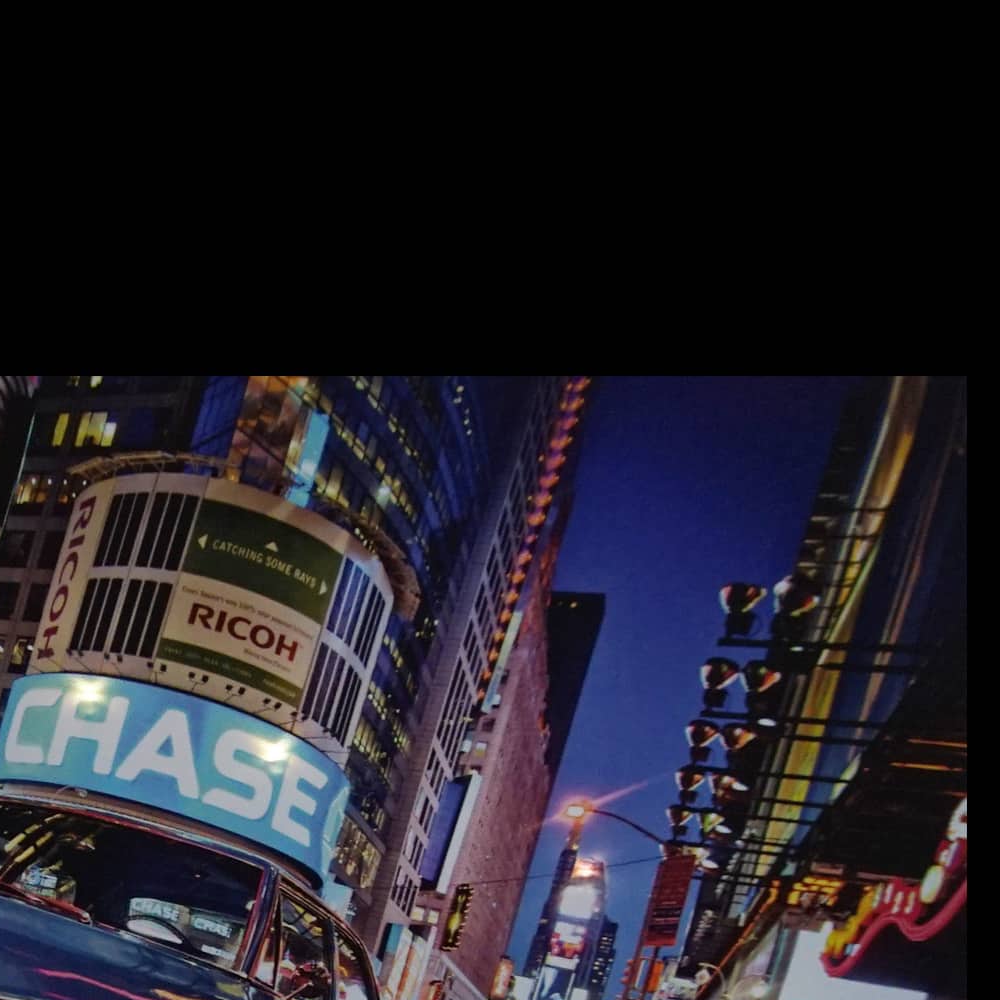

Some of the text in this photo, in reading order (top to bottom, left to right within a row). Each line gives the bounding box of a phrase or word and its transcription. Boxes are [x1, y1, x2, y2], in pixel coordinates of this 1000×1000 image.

[37, 496, 96, 659] RICOH
[212, 539, 318, 590] CATCHING SOME RAYS
[187, 602, 298, 662] RICOH
[4, 687, 328, 848] CHASE
